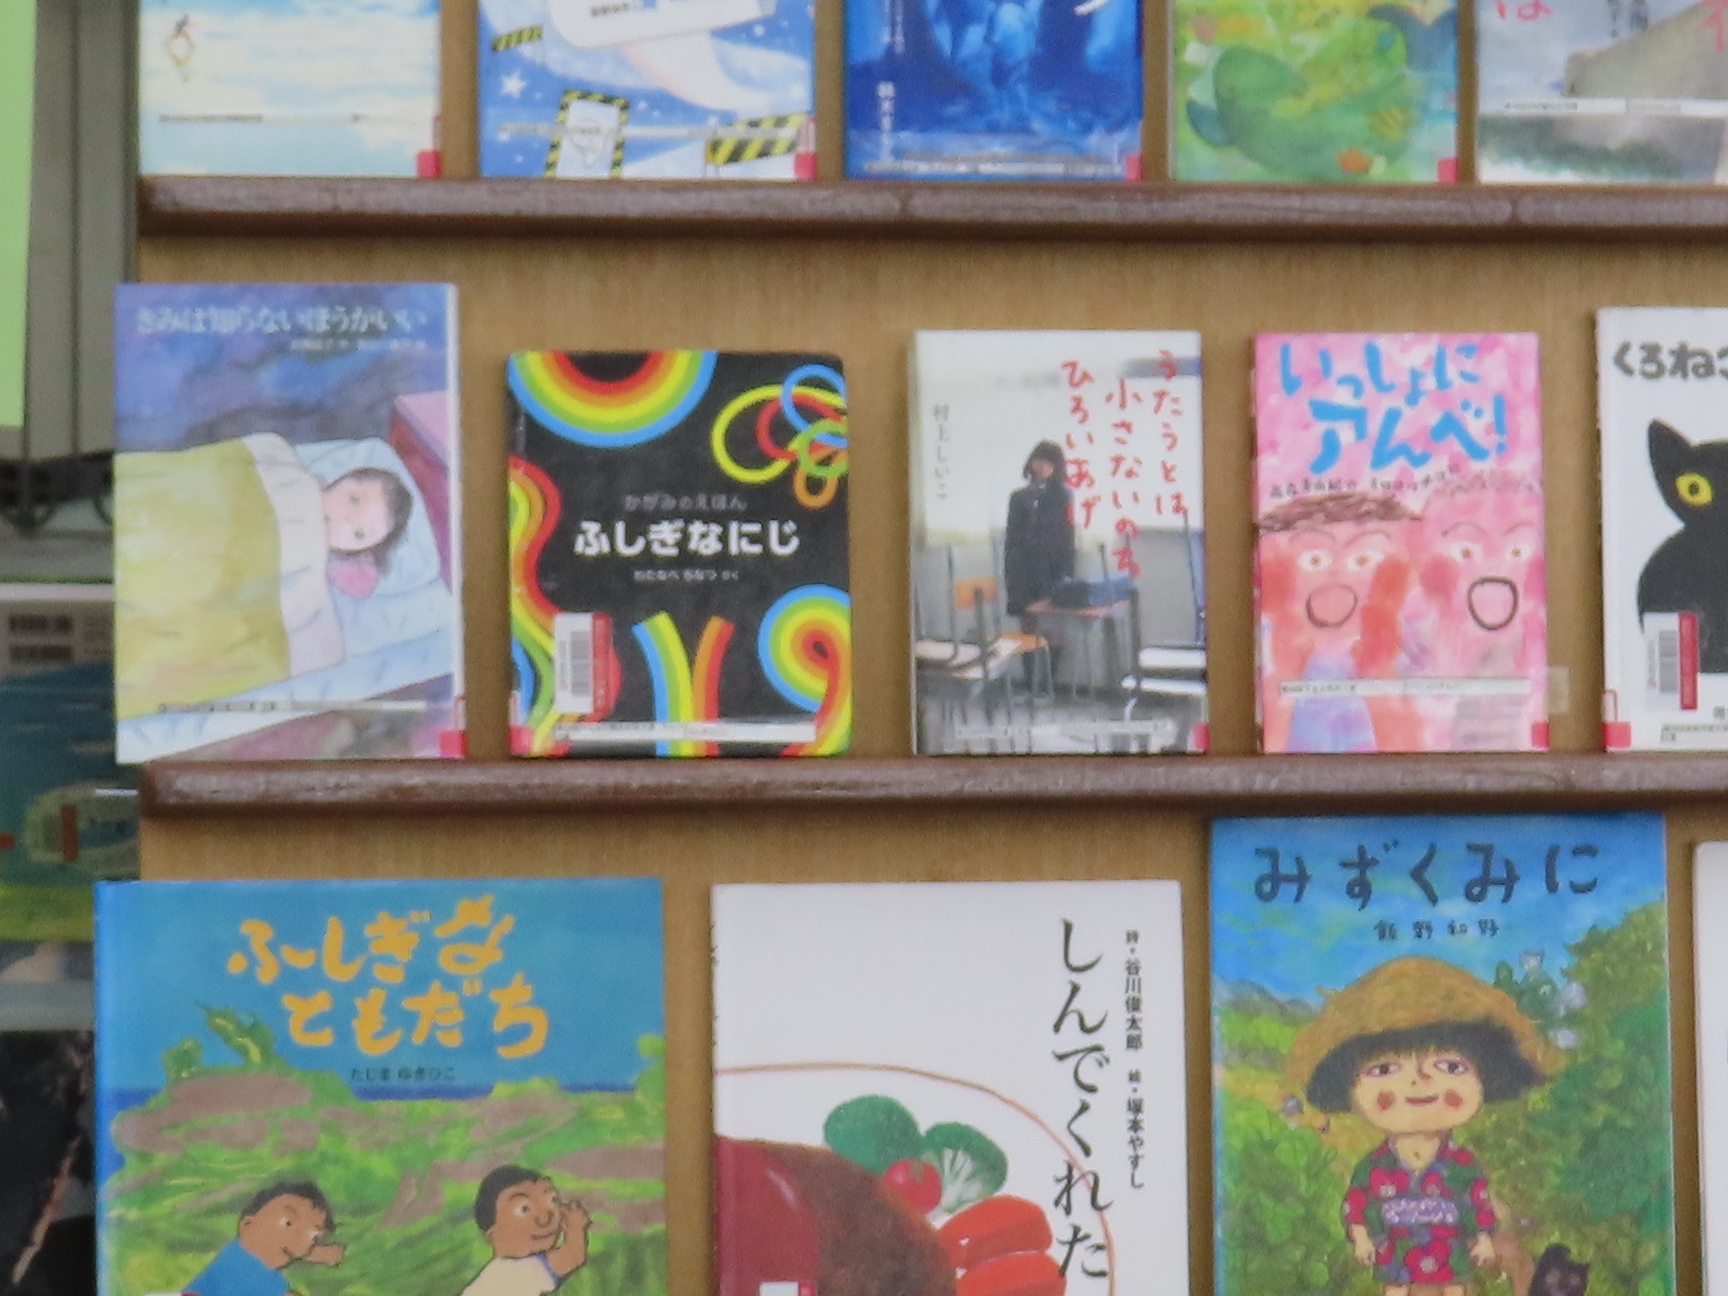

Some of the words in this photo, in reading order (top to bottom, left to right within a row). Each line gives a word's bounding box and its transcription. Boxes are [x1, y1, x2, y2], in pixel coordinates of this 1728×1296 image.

[1280, 341, 1480, 407] いっしょに
[1153, 349, 1189, 516] うたうとは
[1106, 379, 1145, 579] 小さないのち
[575, 519, 801, 557] ふしぎなにじ
[1254, 839, 1599, 911] みずくみに
[281, 973, 549, 1058] ともだち
[1051, 917, 1115, 1279] しんでくれた
